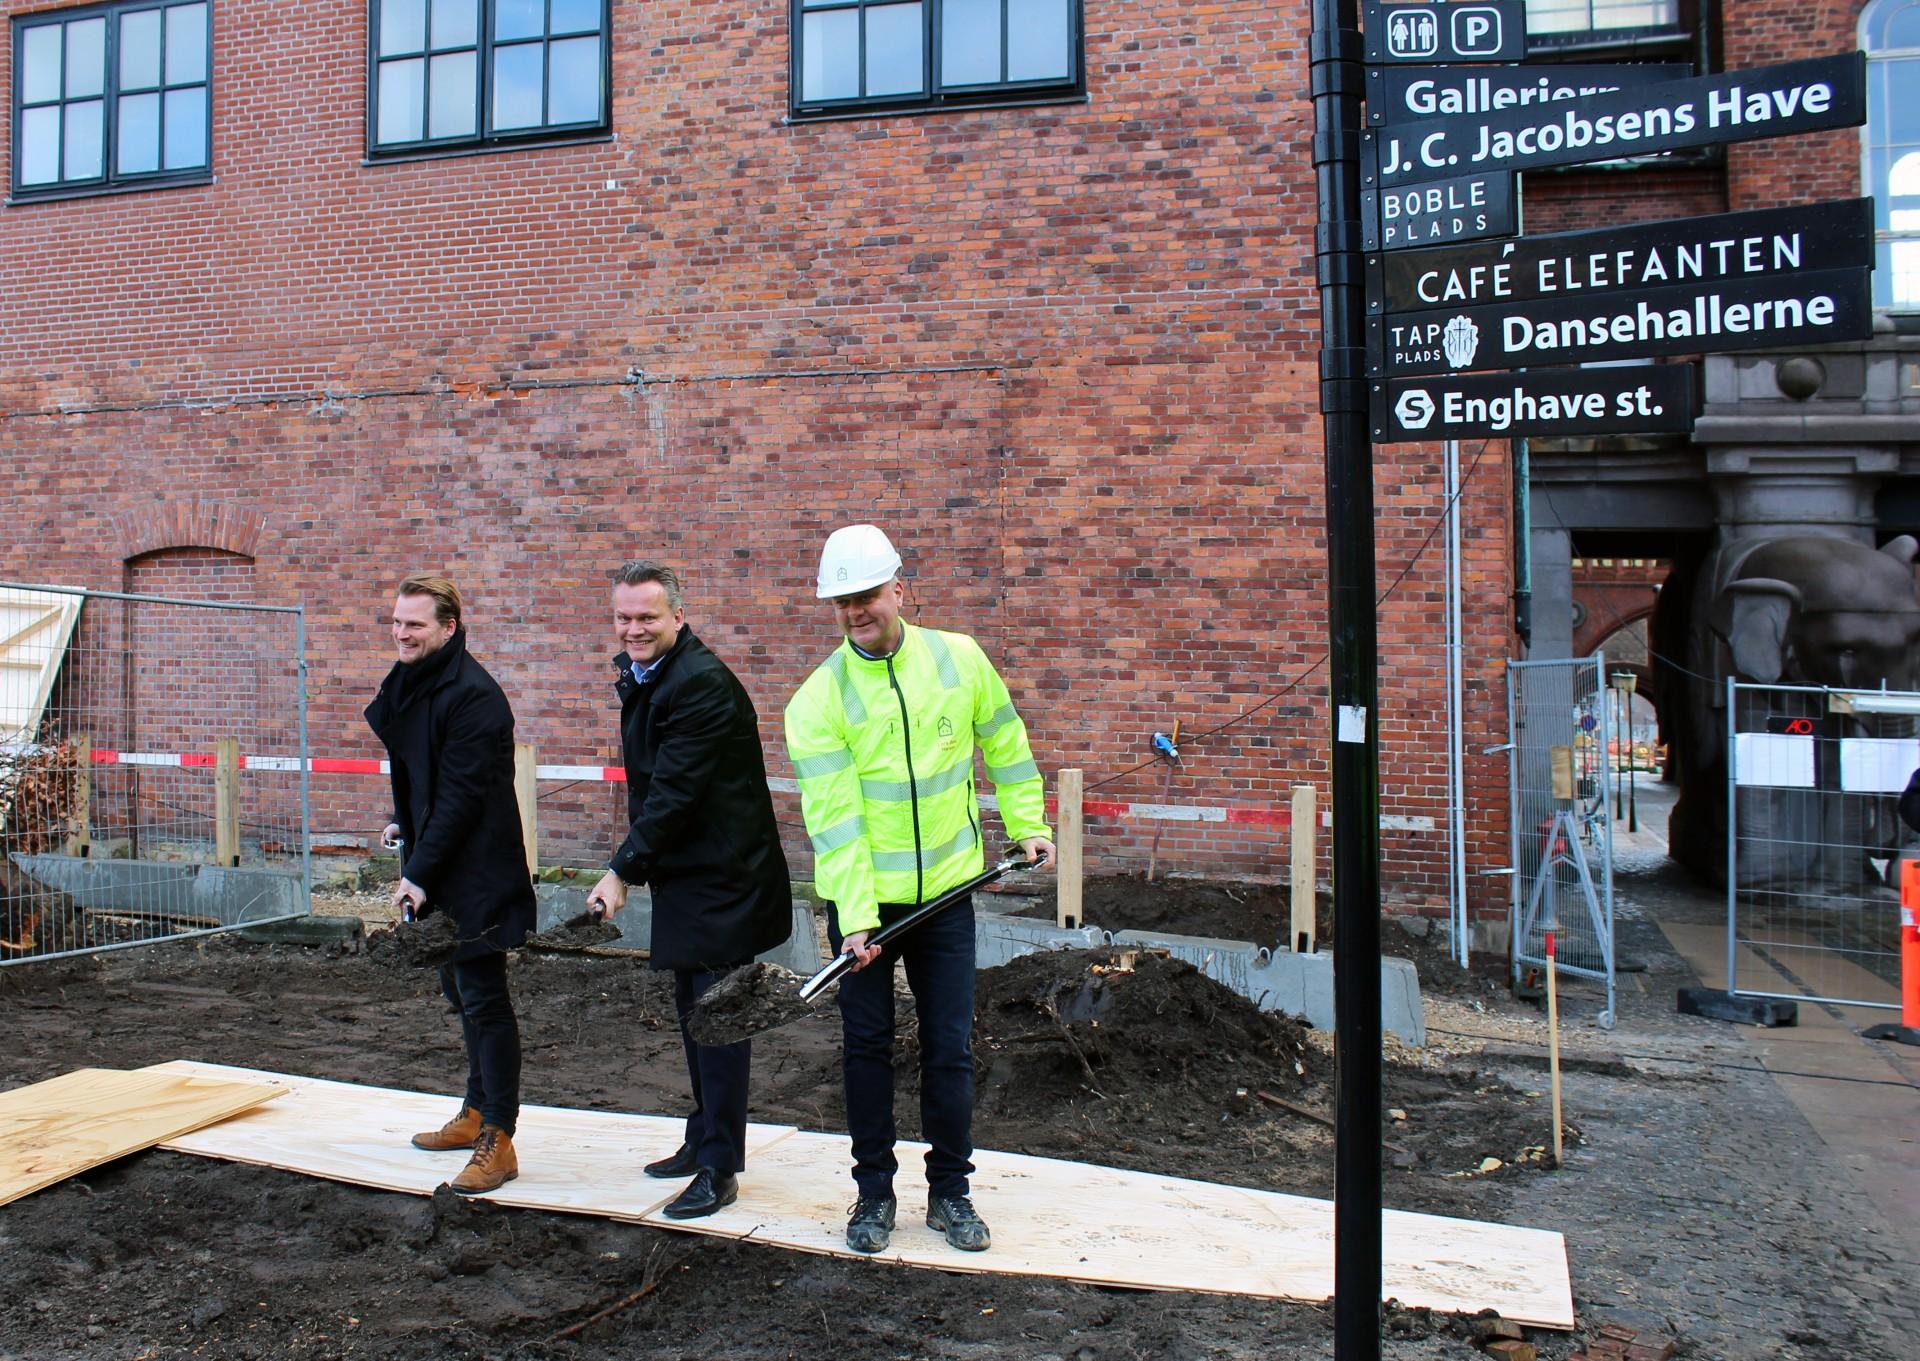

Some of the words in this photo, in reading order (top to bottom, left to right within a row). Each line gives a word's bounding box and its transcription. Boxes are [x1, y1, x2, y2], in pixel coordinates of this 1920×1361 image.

[1466, 16, 1490, 47] P
[1405, 78, 1620, 114] Galleri
[1471, 103, 1695, 162] Jacobsens
[1708, 82, 1831, 128] Have
[1384, 181, 1486, 220] BOBLE
[1385, 214, 1487, 244] PLADS
[1417, 242, 1515, 303] CAFÉ
[1538, 233, 1800, 292] ELEFANTEN
[1391, 323, 1441, 347] TAP
[1503, 295, 1835, 353] Dansehallerne
[1395, 349, 1441, 364] PLADS
[1443, 387, 1606, 430] Enghave
[1616, 385, 1663, 417] st.
